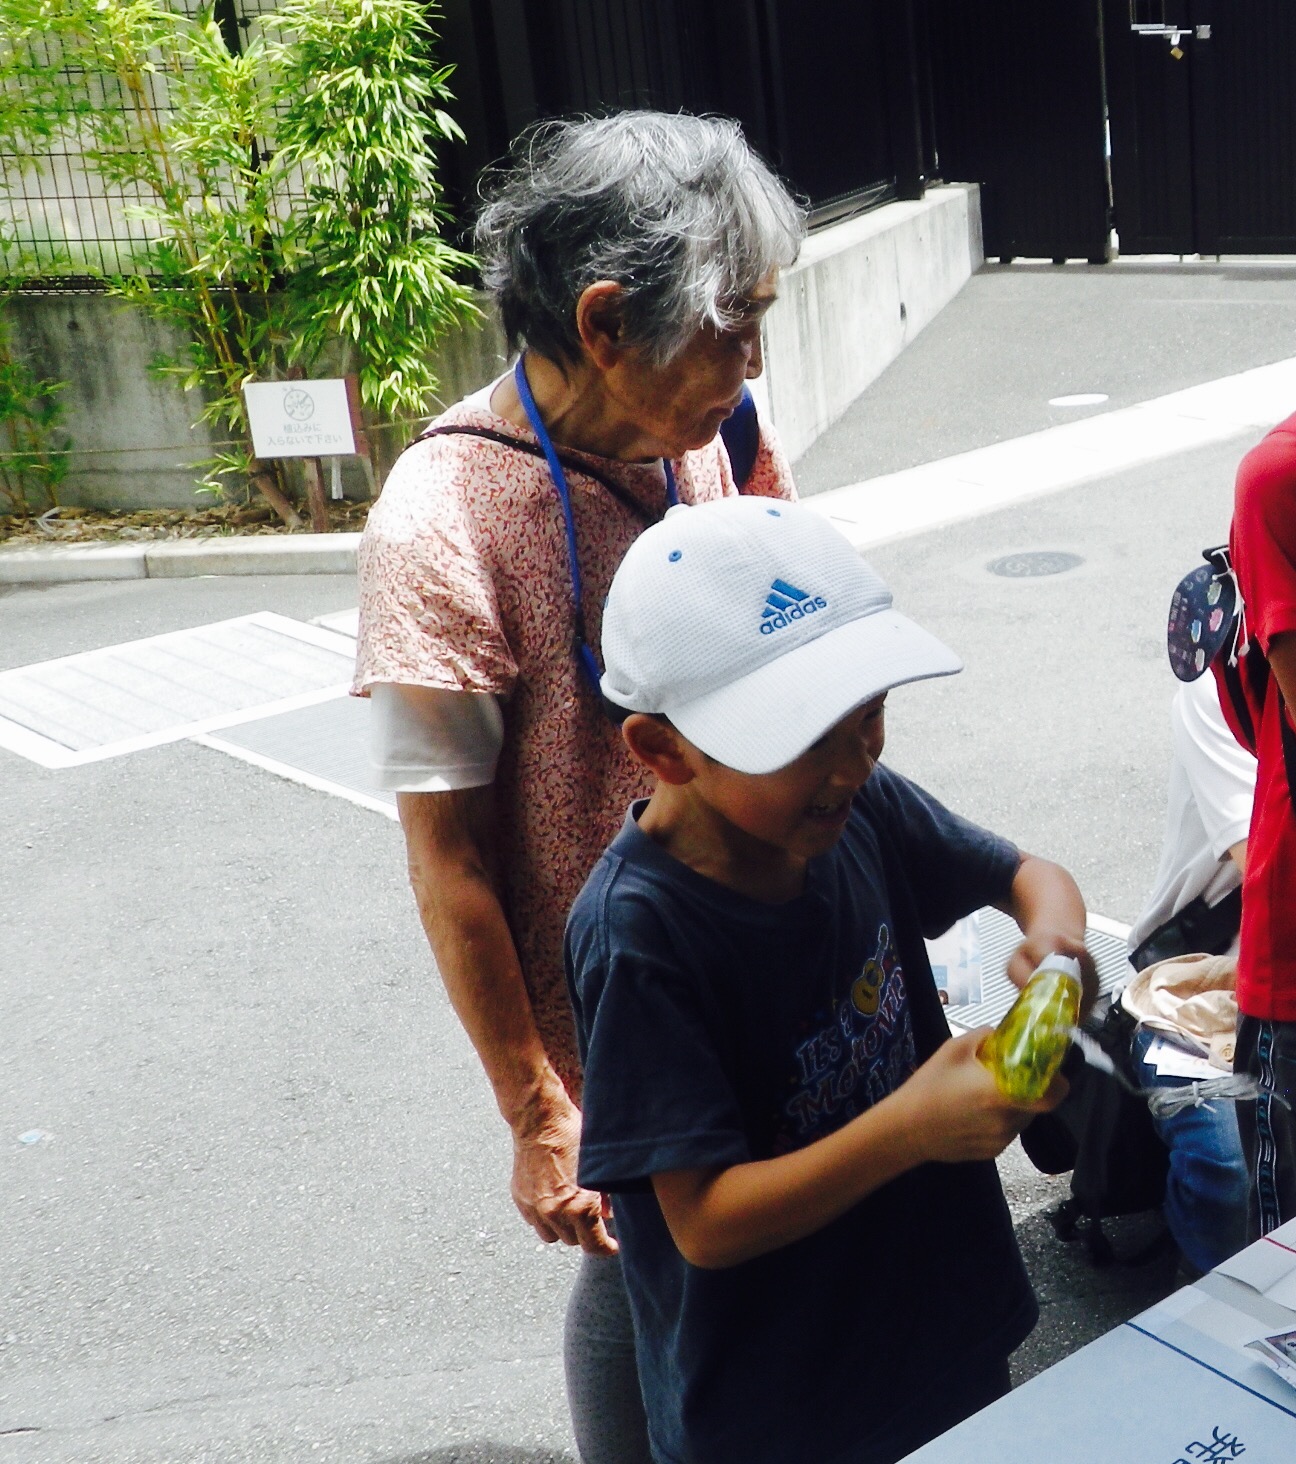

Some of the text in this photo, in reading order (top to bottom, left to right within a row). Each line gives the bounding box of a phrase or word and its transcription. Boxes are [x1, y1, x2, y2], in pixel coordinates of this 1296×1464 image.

[284, 423, 321, 433] 植込みに
[267, 435, 342, 446] 入らないで下さい
[759, 596, 827, 635] adidas
